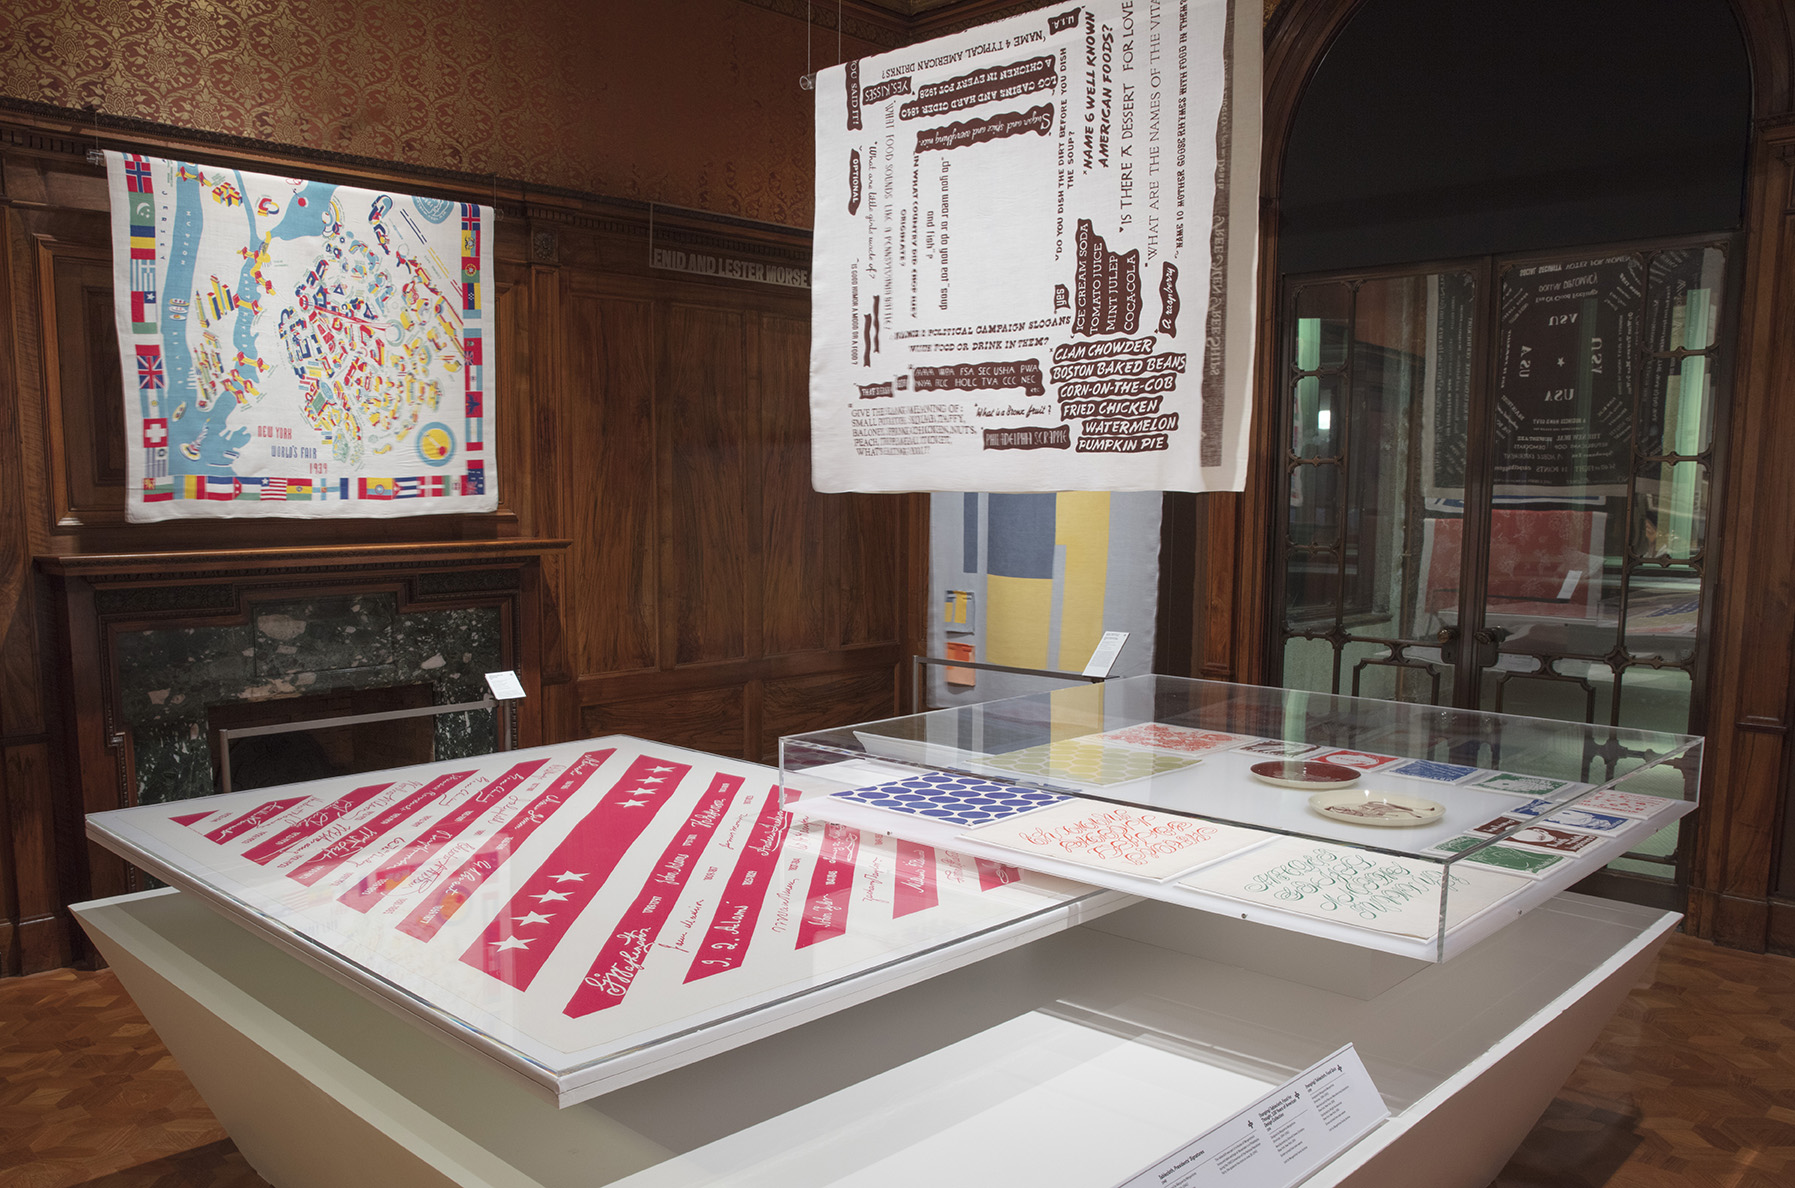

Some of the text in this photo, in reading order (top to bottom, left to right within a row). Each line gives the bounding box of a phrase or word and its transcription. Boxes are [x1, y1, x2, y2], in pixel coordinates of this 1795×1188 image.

[1179, 32, 1187, 44] IN
[965, 41, 1004, 58] TYPICAL
[1122, 40, 1134, 72] FOR
[1178, 45, 1187, 70] FOOD
[882, 63, 916, 79] DRINKS?
[918, 53, 962, 71] AMERICAN
[920, 58, 1052, 99] A CHICKEN IN EVERY POT 1928
[1179, 71, 1187, 95] WITH
[864, 85, 891, 102] KISSES
[901, 75, 1057, 119] LOG CABINS AND HARD CIDER 1840
[1083, 11, 1097, 169] NAME 6 WELL KNOWN
[1098, 24, 1114, 168] AMERICAN FOODS?
[885, 102, 894, 128] WHAT
[1024, 110, 1051, 130] Sugar
[1059, 99, 1067, 138] BEFORE
[1121, 83, 1135, 140] DESSERT
[1177, 97, 1187, 137] RHYMES
[971, 124, 987, 140] and
[987, 121, 1005, 136] spice
[1006, 119, 1023, 133] and
[935, 127, 971, 147] everything
[1148, 33, 1161, 260] WHAT ARE THE NAMES OF THE
[885, 135, 895, 161] FOOD
[1121, 144, 1132, 157] A
[1177, 137, 1186, 167] GOOSE
[869, 146, 877, 171] What
[913, 155, 919, 167] IN
[942, 160, 951, 173] do
[1067, 131, 1075, 189] THE SOUP?
[884, 164, 894, 199] SOUNDS
[940, 175, 949, 191] you
[1120, 162, 1133, 209] THERE
[1177, 169, 1185, 207] MOTHER
[868, 192, 877, 211] little
[865, 214, 877, 234] girls
[927, 211, 935, 228] and
[941, 221, 948, 231] or
[1121, 214, 1132, 225] IS
[941, 234, 950, 245] do
[1176, 223, 1184, 248] NAME
[939, 248, 948, 264] you
[1056, 240, 1063, 253] DO
[654, 248, 808, 287] ENID AND LESTER MORSE
[941, 267, 949, 282] eat
[1076, 223, 1089, 330] ICE CREAM SODA
[1056, 288, 1067, 306] yes
[1090, 242, 1102, 334] TOMATO JUICE
[1106, 255, 1119, 331] MINT JULEP
[1163, 267, 1176, 315] raspberry
[976, 321, 1026, 335] CAMPAIGN
[1028, 315, 1072, 330] SLOGANS
[957, 343, 970, 351] OR
[972, 340, 1003, 351] DRINK
[1005, 339, 1017, 349] IN
[1018, 337, 1050, 348] THEM?
[1055, 339, 1152, 360] CLAM CHOWDER
[960, 364, 1038, 376] FSA SEC USHA PWA
[1053, 355, 1186, 380] BOSTON BAKED BEANS
[954, 378, 977, 387] HOLC
[982, 378, 998, 386] TVA
[1002, 377, 1016, 385] CCC
[1021, 375, 1036, 384] NEC
[1060, 376, 1174, 398] CORN-ON-THE-COB
[976, 407, 995, 417] What
[1063, 400, 1158, 417] FRIED CHICKEN
[257, 425, 293, 440] NEW YORK
[1085, 416, 1177, 433] WATERMELON
[1034, 429, 1067, 445] SCRAPPLE
[1078, 436, 1165, 452] PUMPKIN PIE
[271, 445, 317, 459] WORLD'S FAIR
[309, 463, 328, 474] 1939
